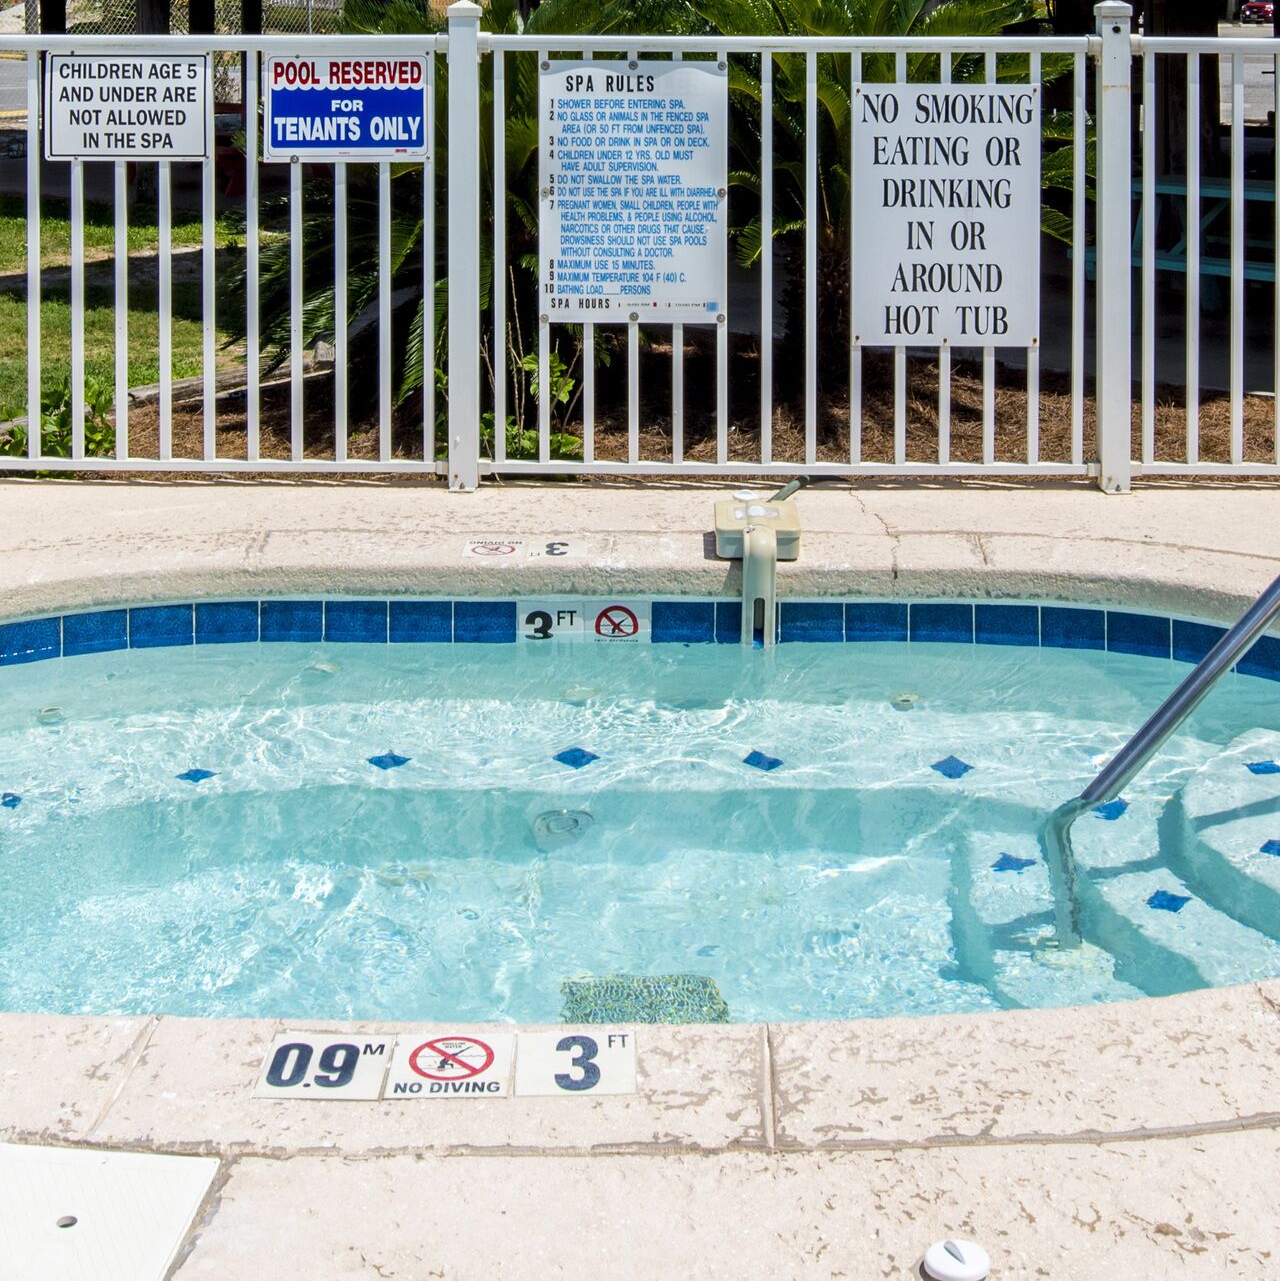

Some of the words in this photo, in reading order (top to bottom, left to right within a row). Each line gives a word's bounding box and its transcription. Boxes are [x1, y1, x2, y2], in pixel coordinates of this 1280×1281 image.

[59, 63, 143, 79] CHILDREN
[148, 63, 182, 79] AGE
[187, 63, 197, 79] 5
[273, 61, 320, 85] POOL
[329, 61, 422, 85] RESERVED
[566, 75, 594, 92] SPA
[606, 75, 654, 92] RULES
[59, 86, 94, 102] AND
[99, 86, 157, 102] UNDER
[162, 86, 197, 102] ARE
[331, 99, 364, 112] FOR
[550, 99, 554, 108] 1
[558, 99, 591, 109] SHOWER
[594, 99, 624, 109] BEFORE
[628, 99, 666, 109] ENTERING
[669, 99, 685, 109] SPA.
[861, 93, 899, 124] NO
[914, 93, 1034, 125] SMOKING
[69, 109, 102, 126] NOT
[106, 109, 187, 126] ALLOWED
[550, 111, 554, 120] 2
[558, 112, 568, 121] NO
[570, 112, 593, 121] GLASS
[596, 112, 606, 121] OR
[609, 112, 638, 121] ANIMALS
[641, 112, 648, 121] IN
[650, 112, 663, 122] THE
[666, 112, 693, 122] FENCED
[696, 112, 709, 122] SPA
[273, 116, 361, 142] TENANTS
[370, 116, 421, 142] ONLY
[562, 124, 581, 134] AREA
[584, 124, 596, 134] (OR
[600, 124, 609, 134] 50
[612, 124, 620, 133] FT
[623, 124, 643, 134] FROM
[646, 124, 684, 134] UNFENCED
[83, 132, 99, 149] IN
[104, 132, 136, 149] THE
[140, 132, 174, 149] SPA
[550, 136, 554, 145] 3
[557, 137, 568, 147] NO
[571, 137, 592, 147] FOOD
[595, 137, 606, 146] OR
[609, 137, 630, 146] DRINK
[634, 137, 641, 146] IN
[644, 137, 657, 147] SPA
[660, 137, 671, 147] OR
[674, 137, 685, 147] ON
[688, 137, 710, 147] DECK.
[549, 150, 554, 159] 4
[558, 150, 594, 160] CHILDREN
[597, 150, 622, 160] UNDER
[626, 150, 632, 160] 12
[636, 150, 651, 160] YRS.
[655, 150, 670, 160] OLD
[673, 150, 694, 160] MUST
[873, 135, 970, 166] EATING
[985, 136, 1022, 166] OR
[561, 162, 580, 171] HAVE
[583, 162, 605, 171] ADULT
[608, 162, 658, 172] SUPERVISION.
[550, 174, 554, 183] 5
[558, 174, 568, 184] DO
[571, 174, 585, 184] NOT
[588, 175, 622, 185] SWALLOW
[625, 175, 638, 184] THE
[642, 175, 654, 185] SPA
[657, 175, 682, 184] WATER.
[881, 178, 1012, 209] DRINKING
[550, 200, 554, 209] 7
[558, 200, 590, 210] PREGNANT
[620, 200, 640, 210] SMALL
[677, 200, 700, 210] PEOPLE
[703, 200, 718, 210] WITH
[561, 224, 598, 234] NARCOTICS
[601, 224, 611, 233] OR
[614, 224, 635, 233] OTHER
[638, 224, 661, 234] DRUGS
[664, 224, 680, 234] THAT
[906, 220, 935, 251] IN
[950, 220, 986, 251] OR
[560, 236, 604, 245] DROWSINESS
[608, 236, 634, 245] SHOULD
[637, 236, 650, 245] NOT
[653, 236, 666, 246] USE
[670, 236, 682, 246] SPA
[684, 236, 707, 246] POOLS
[561, 247, 590, 257] WITHOUT
[593, 247, 635, 257] CONSULTING
[637, 248, 642, 257] A
[550, 259, 554, 269] 8
[558, 260, 592, 269] MAXIMUM
[595, 260, 608, 270] USE
[612, 260, 619, 270] 15
[622, 260, 655, 270] MINUTES.
[550, 271, 554, 280] 9
[557, 272, 589, 282] MAXIMUM
[592, 273, 639, 282] TEMPERATURE
[642, 273, 654, 282] 104
[656, 273, 660, 282] F
[663, 272, 677, 282] (40)
[890, 262, 1003, 293] AROUND
[551, 298, 569, 308] SPA
[579, 298, 609, 309] HOURS
[883, 304, 940, 335] HOT
[955, 305, 1009, 335] TUB
[524, 610, 554, 640] 3
[556, 610, 577, 627] FT
[266, 1042, 360, 1088] 0.9
[362, 1043, 386, 1055] M
[554, 1035, 601, 1092] 3
[607, 1034, 630, 1049] FT
[393, 1082, 423, 1094] NO
[429, 1081, 501, 1094] DIVING
